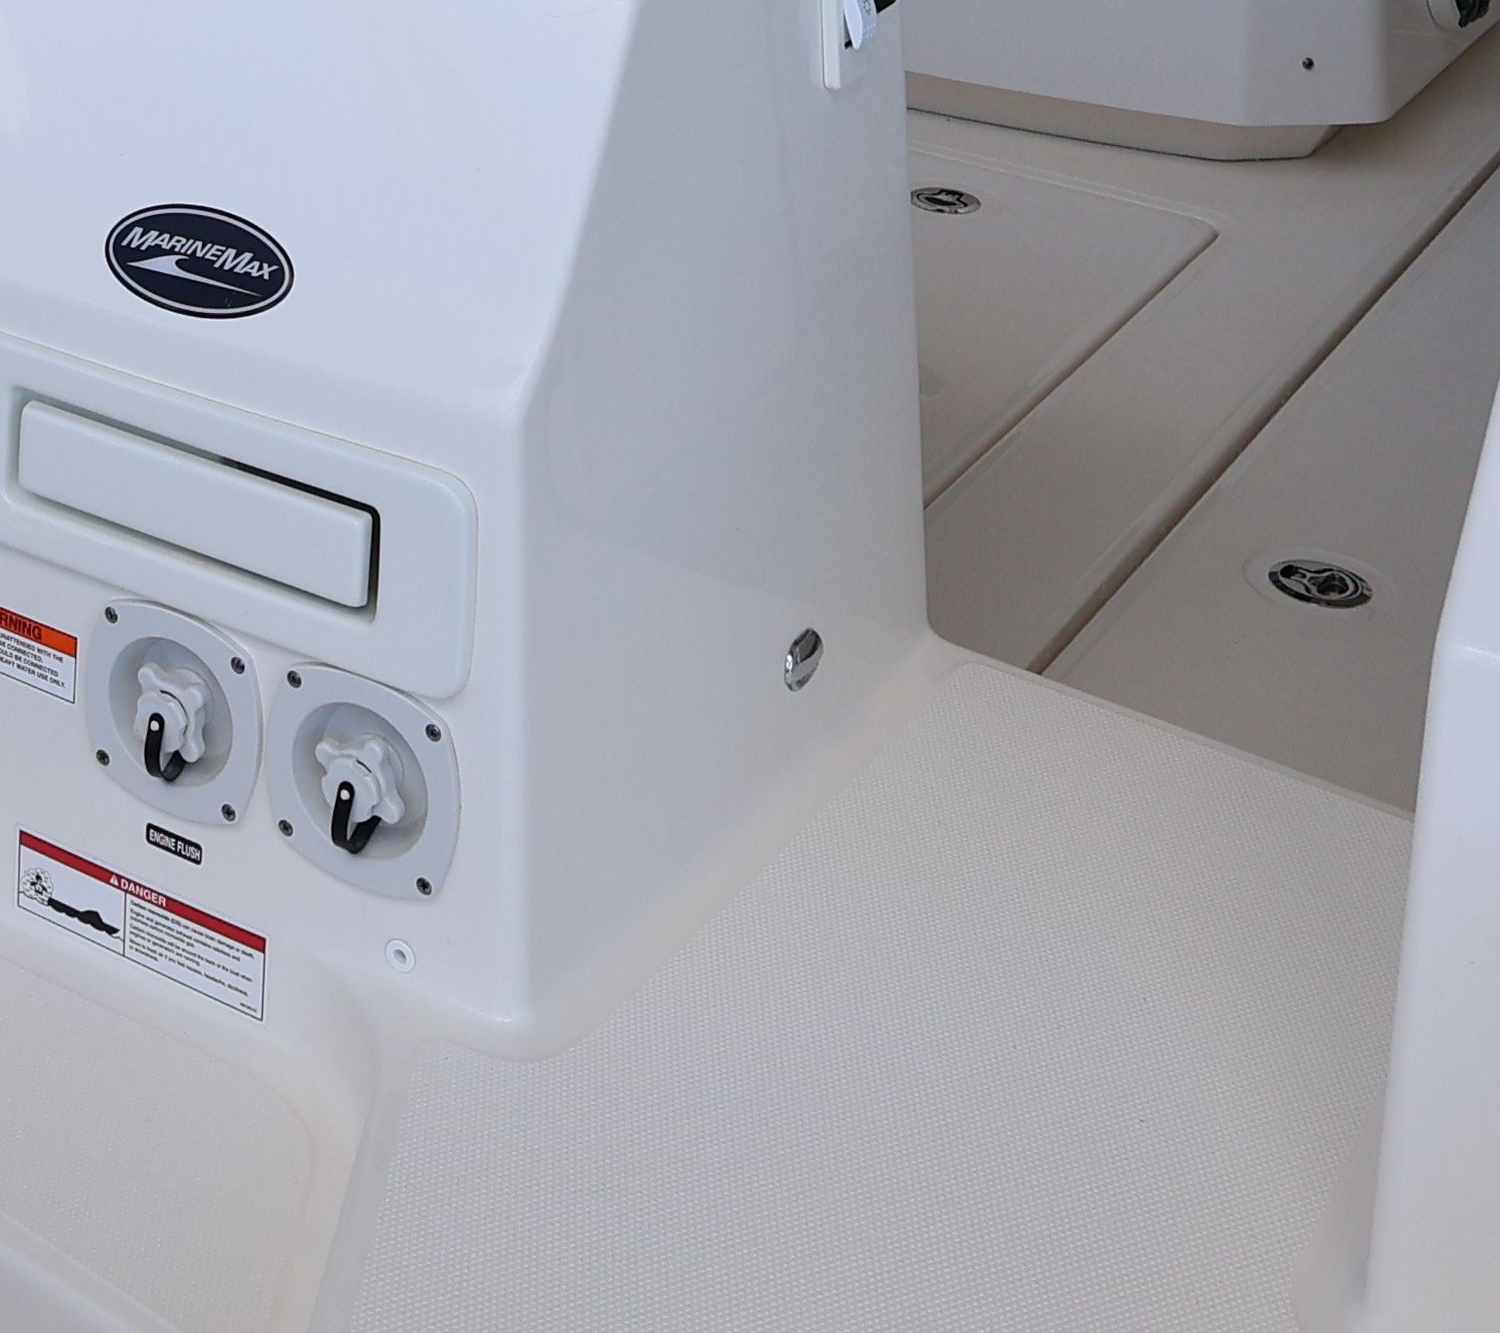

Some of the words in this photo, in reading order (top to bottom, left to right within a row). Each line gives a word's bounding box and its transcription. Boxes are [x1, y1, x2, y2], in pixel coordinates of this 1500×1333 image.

[149, 829, 176, 852] ENGINE
[177, 840, 201, 861] FLUSH
[120, 878, 167, 908] DANGER
